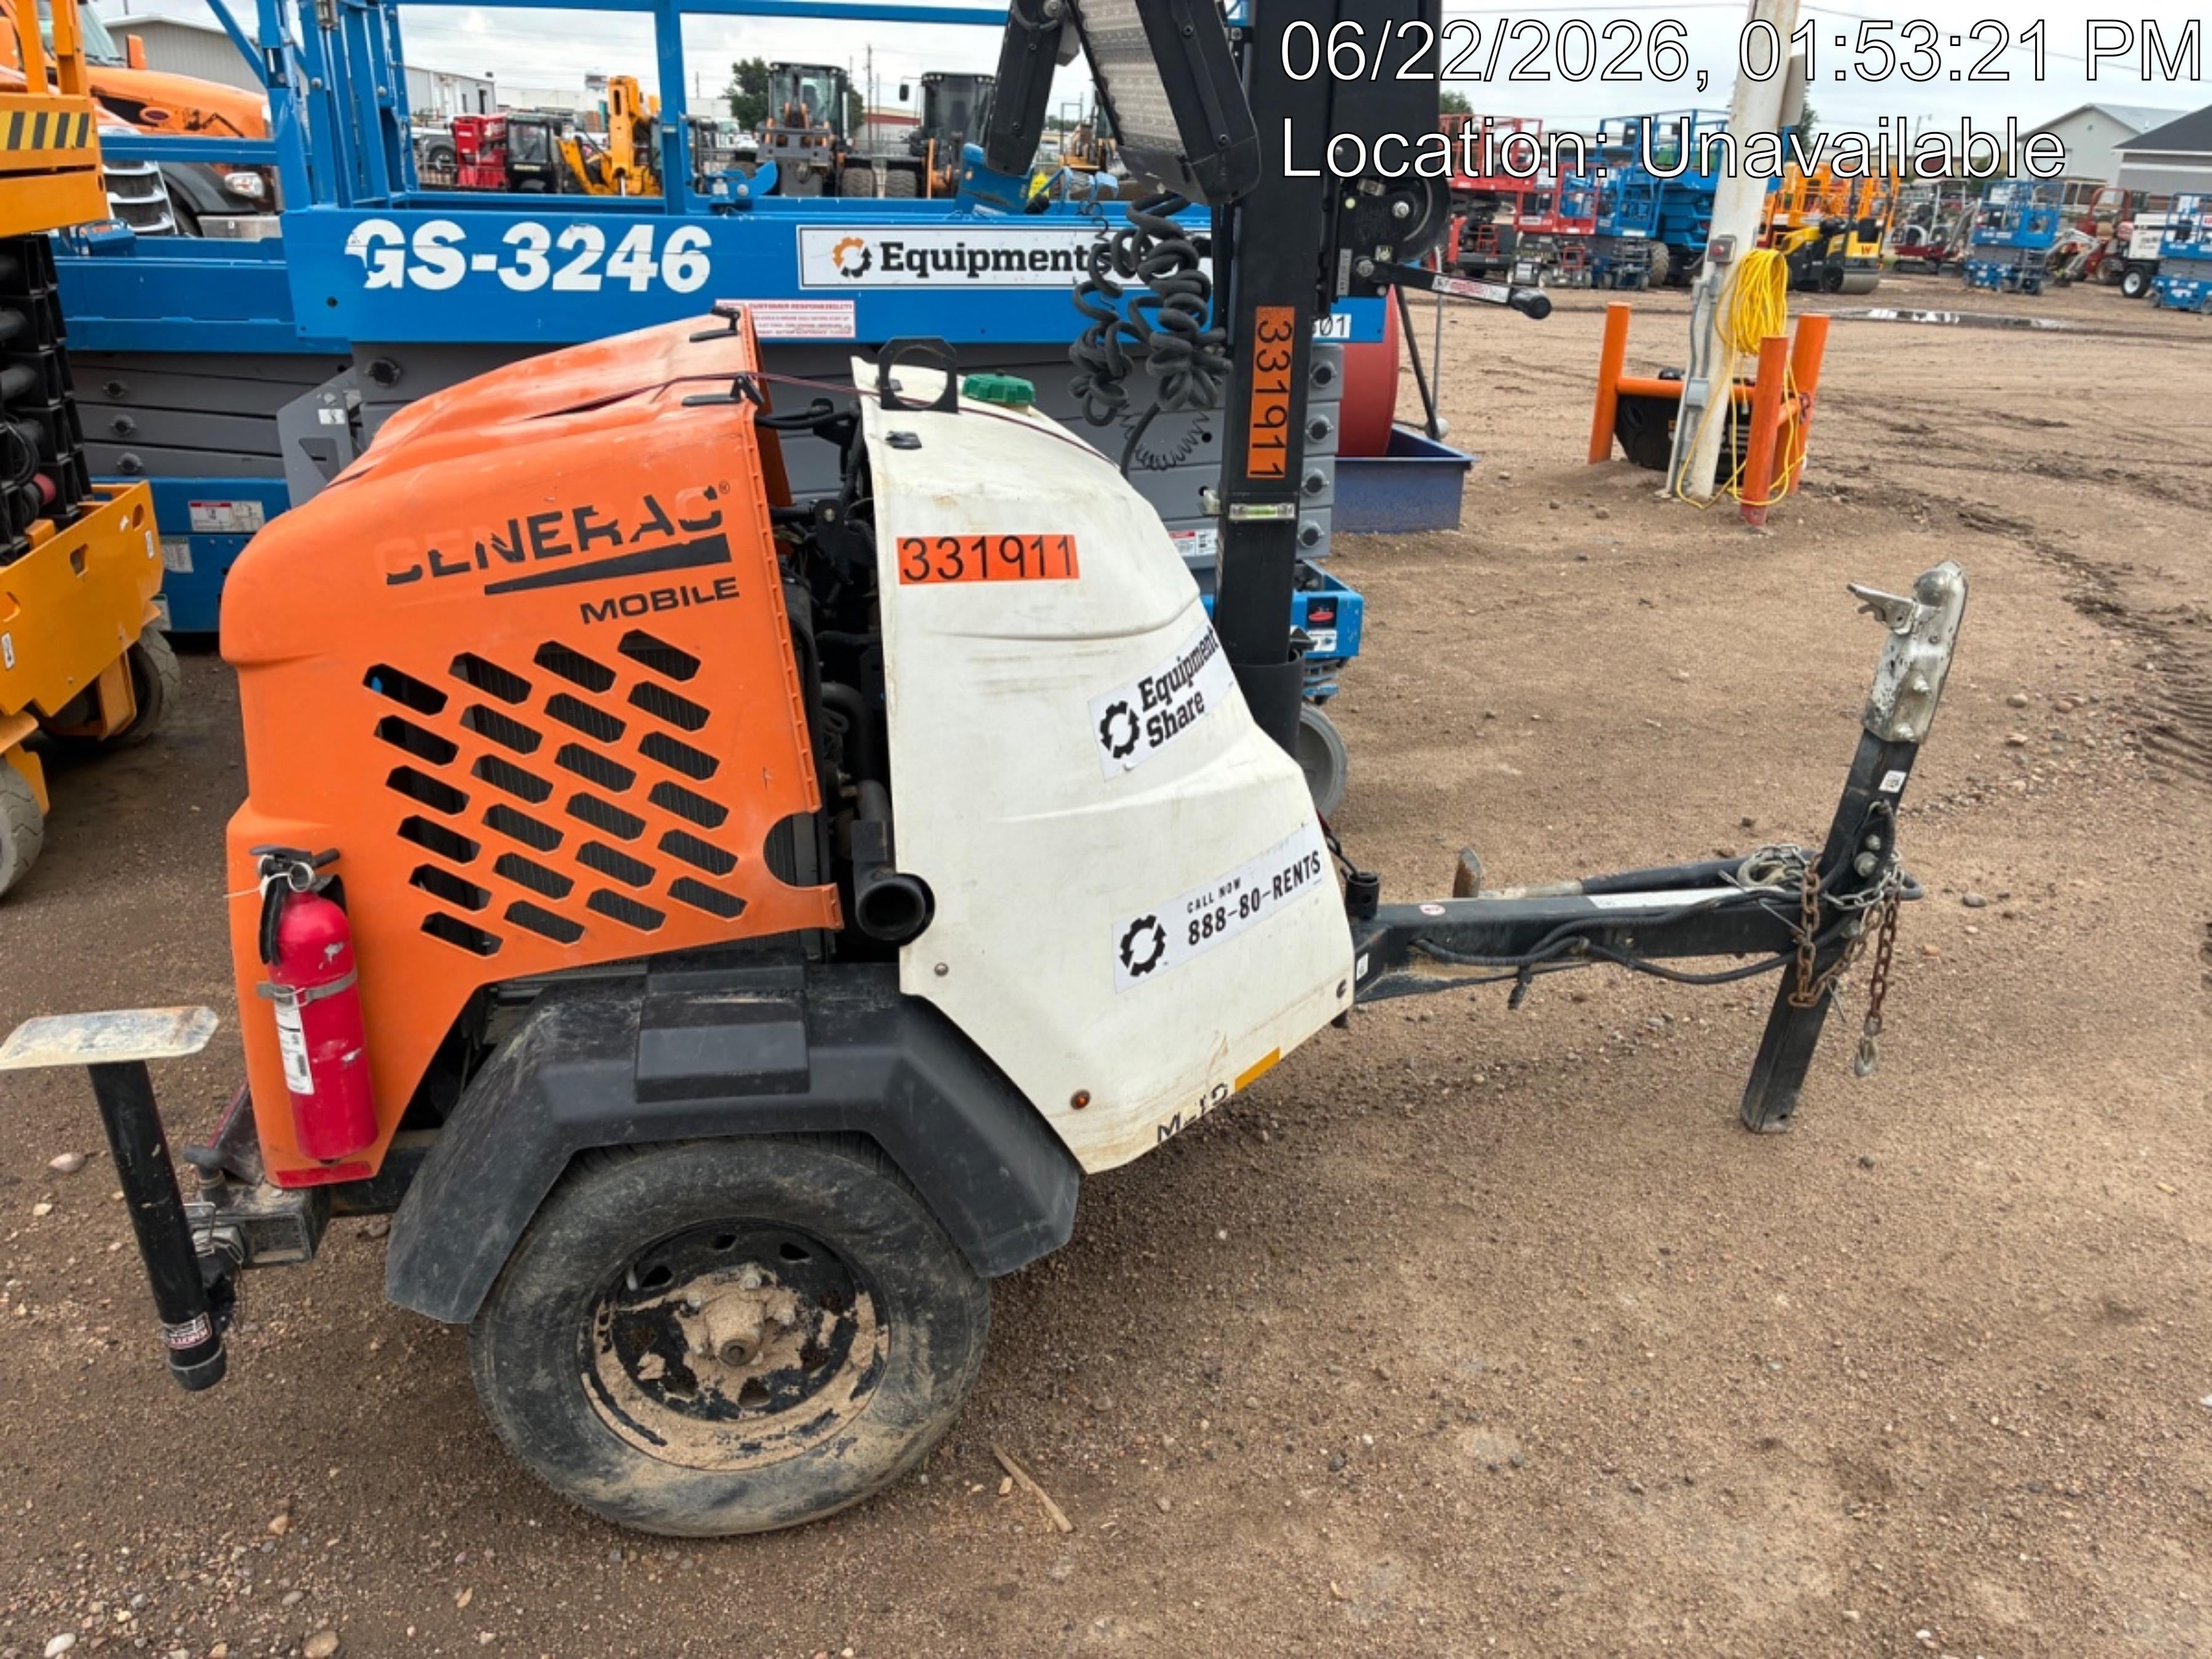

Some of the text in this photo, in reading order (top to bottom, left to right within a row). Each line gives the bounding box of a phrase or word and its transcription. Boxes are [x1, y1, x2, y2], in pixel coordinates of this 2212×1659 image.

[344, 218, 712, 292] GS-3246
[1249, 320, 1292, 476] 331911
[902, 534, 1071, 581] 331911
[579, 576, 740, 625] MOBILE
[1137, 624, 1219, 712] Equipment
[1146, 690, 1205, 748] Share
[1186, 876, 1242, 914] CALL NOW
[1188, 850, 1321, 946] 888-80-RENTS
